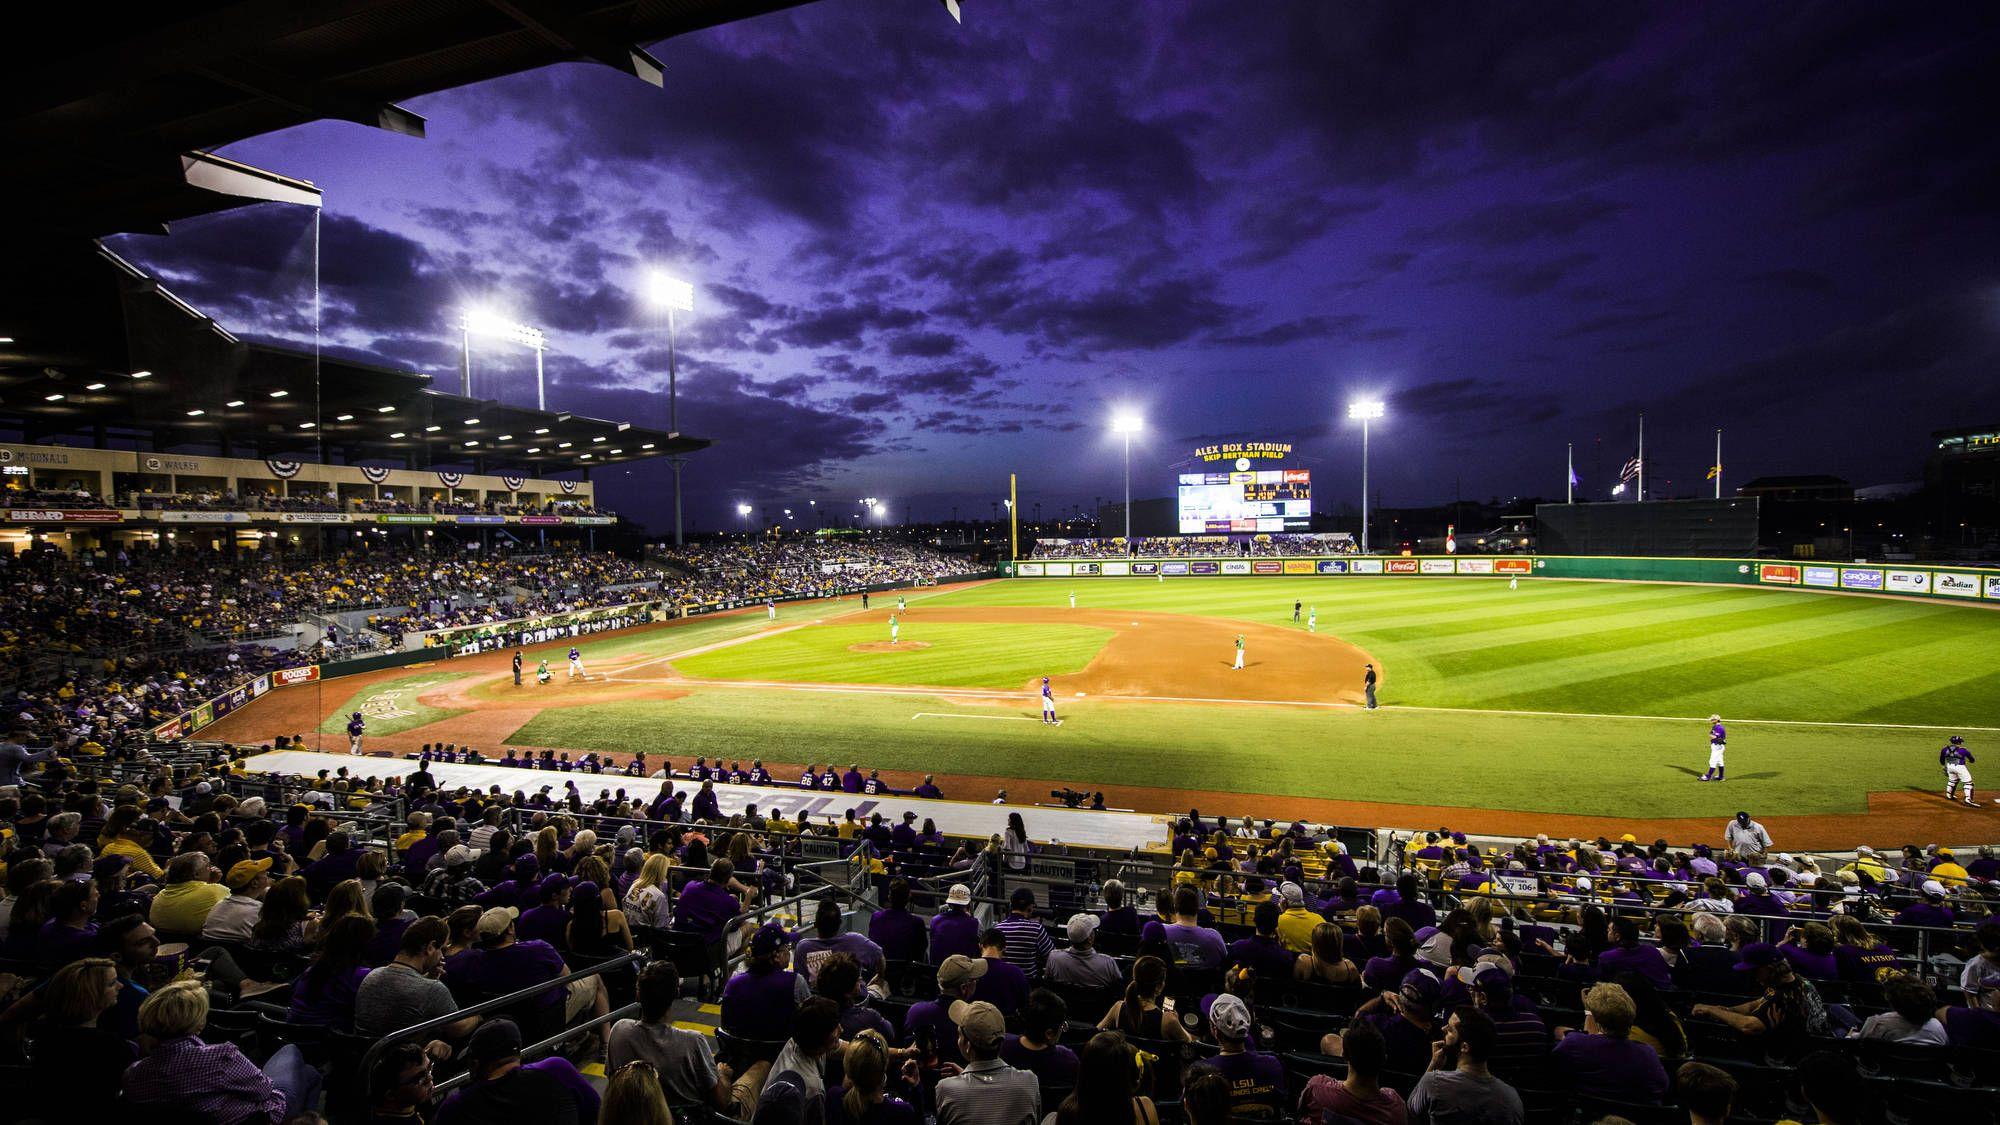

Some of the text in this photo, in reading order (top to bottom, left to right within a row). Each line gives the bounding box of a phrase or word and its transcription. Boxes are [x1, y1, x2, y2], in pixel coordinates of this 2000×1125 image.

[1195, 443, 1292, 457] ALEX BOX STADIUM
[1203, 451, 1284, 462] SKIP BERTMAN FIELD
[1941, 578, 1974, 589] Acadian
[282, 668, 312, 680] ROUSES
[690, 769, 700, 778] 35
[710, 772, 719, 780] 41
[750, 772, 760, 781] 37
[729, 775, 740, 784] 29
[801, 776, 812, 786] 26
[822, 777, 833, 786] 47
[865, 784, 876, 794] 28
[804, 843, 837, 856] CAUTION
[1033, 863, 1073, 877] CAUTION
[1518, 883, 1532, 891] 106
[1861, 954, 1895, 964] WATSON
[1232, 1078, 1254, 1089] LSU
